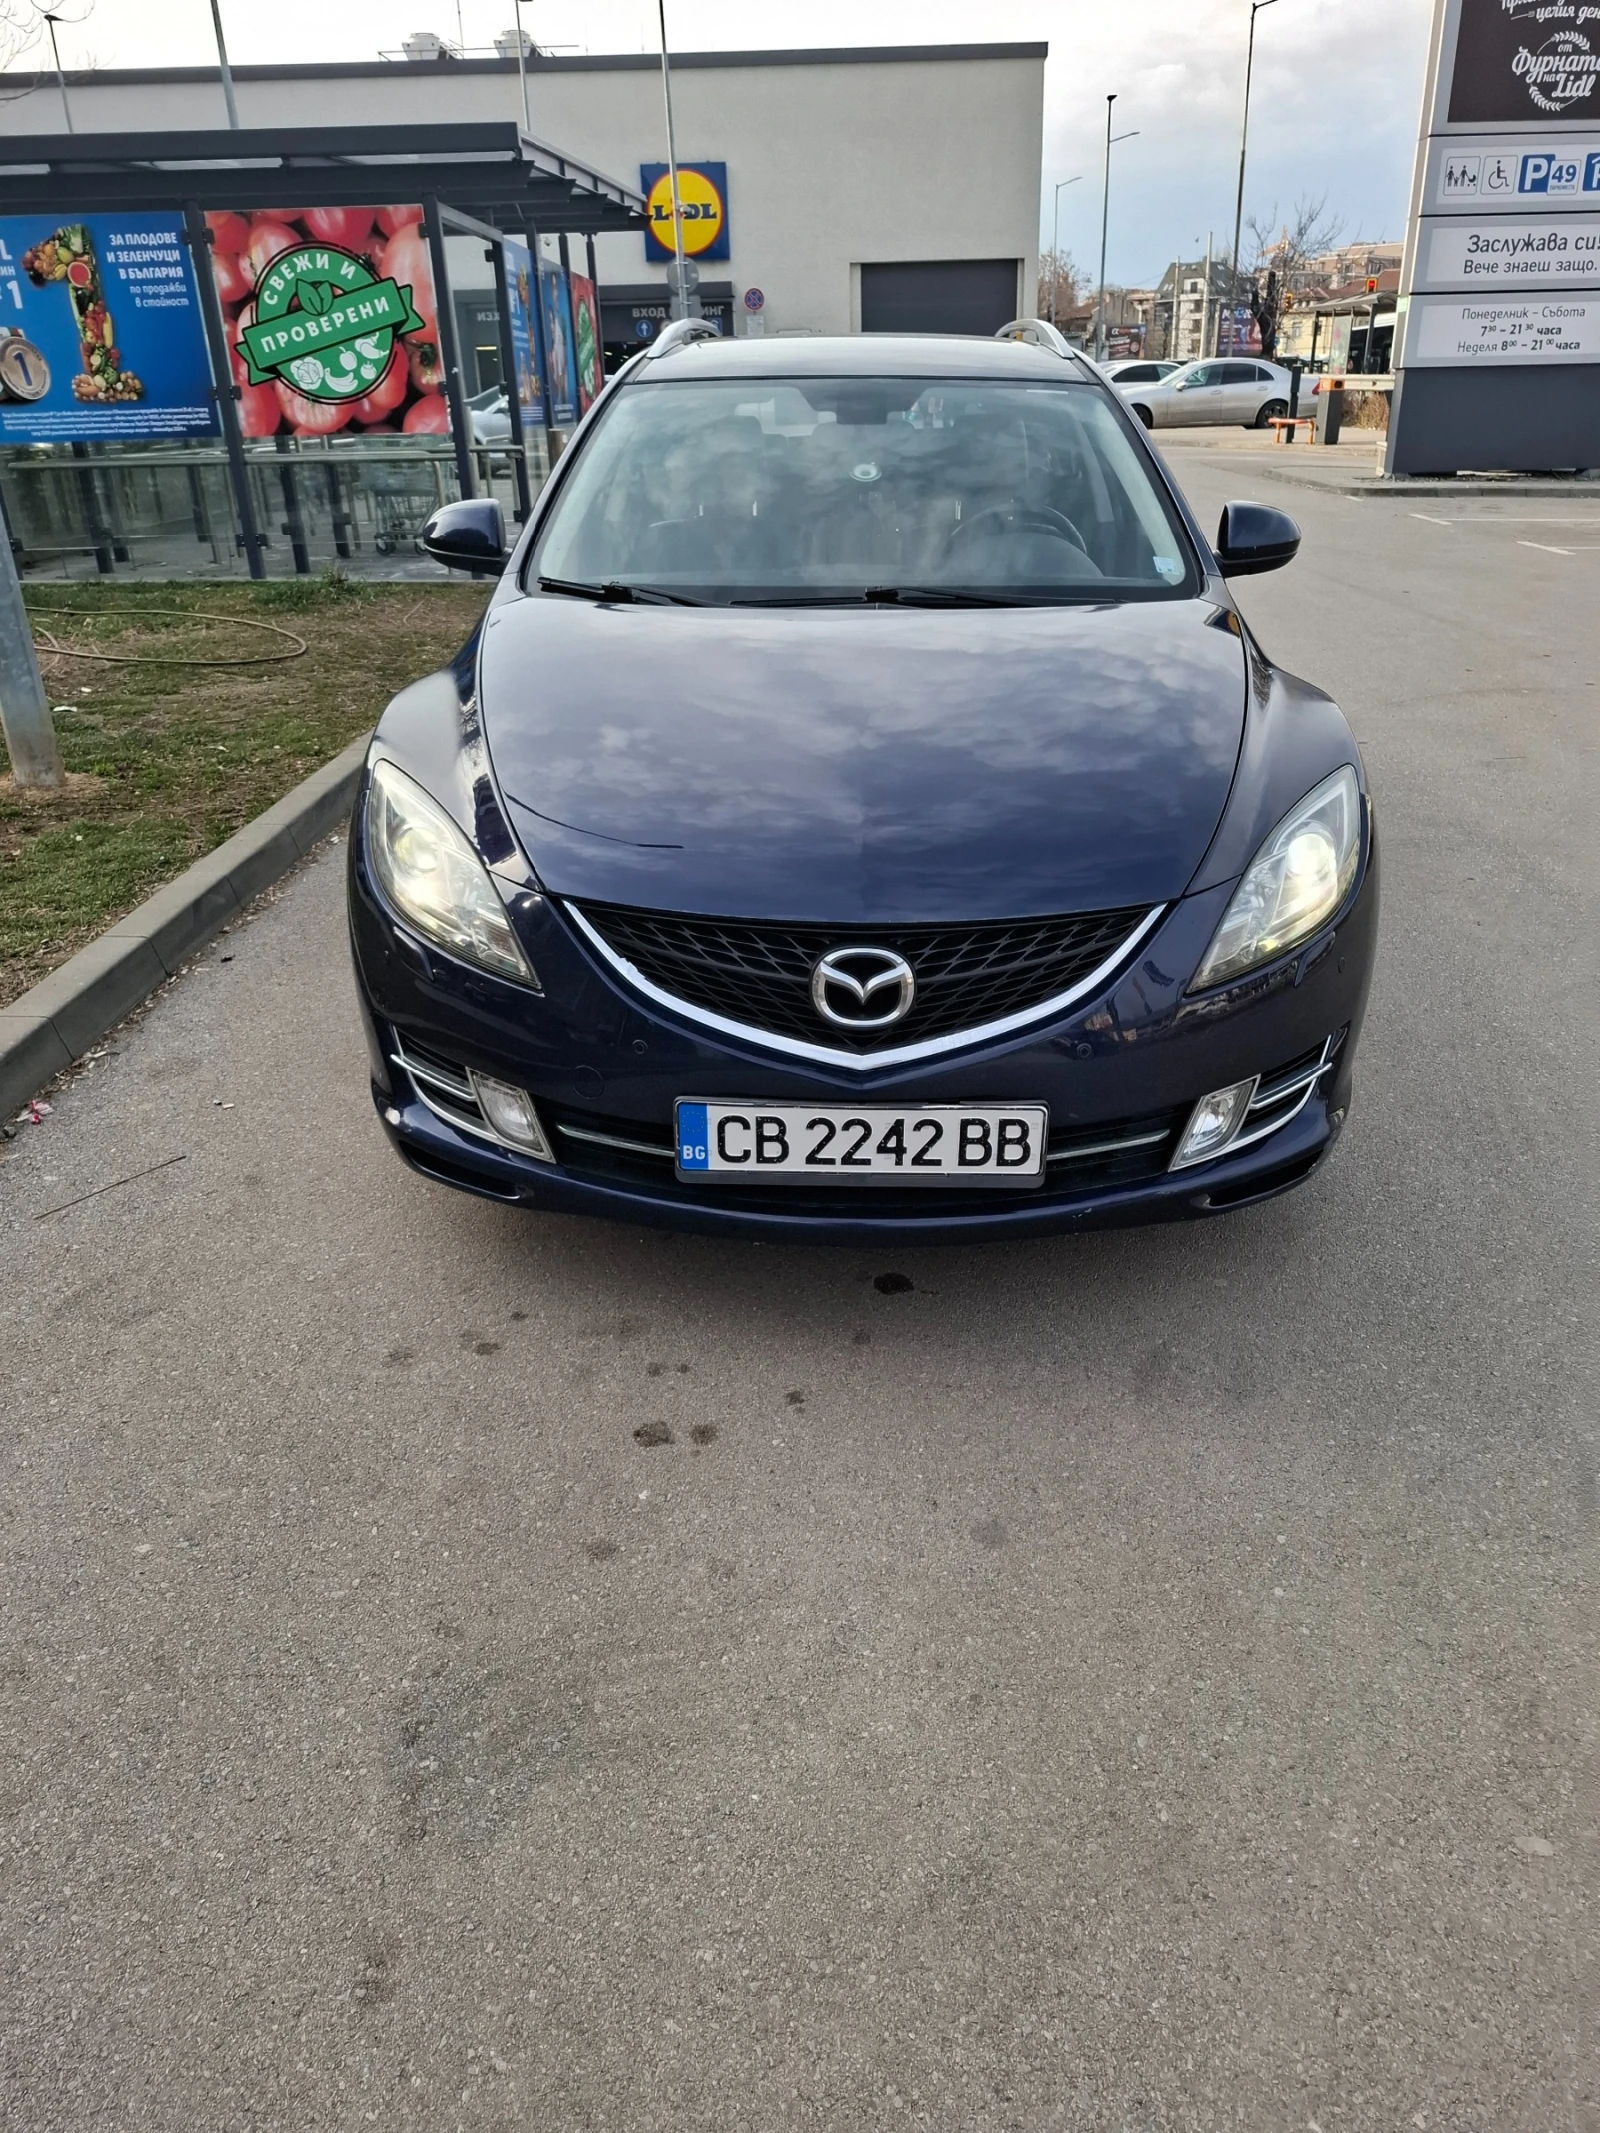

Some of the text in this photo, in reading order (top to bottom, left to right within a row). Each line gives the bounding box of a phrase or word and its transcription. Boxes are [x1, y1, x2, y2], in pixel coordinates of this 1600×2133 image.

[1536, 6, 1575, 22] целия
[1558, 44, 1573, 53] от
[1543, 74, 1556, 82] на
[1551, 73, 1596, 97] Lidl
[1524, 158, 1549, 190] P
[1551, 164, 1577, 183] 49
[653, 203, 717, 221] LDL
[109, 232, 178, 246] ЗА ПЛОДОВЕ
[1467, 232, 1568, 257] Заслужава
[106, 249, 181, 263] И ЗЕЛЕНЧУЦИ
[118, 266, 184, 280] В БЪЛГАРИЯ
[1463, 259, 1598, 274] Вече знаеш защо.
[263, 253, 356, 305] СВЕЖИ И
[6, 280, 23, 309] 1
[129, 282, 187, 295] по продажби
[632, 307, 666, 318] ВХОД
[1461, 307, 1529, 322] Понеделник
[1541, 306, 1586, 318] Събота
[260, 296, 390, 353] ПРОВЕРЕНИ
[1536, 326, 1562, 335] часа
[1457, 341, 1498, 355] Неделя
[1555, 341, 1581, 350] часа
[716, 1115, 1032, 1168] CB 2242 BB
[682, 1145, 706, 1160] BG
